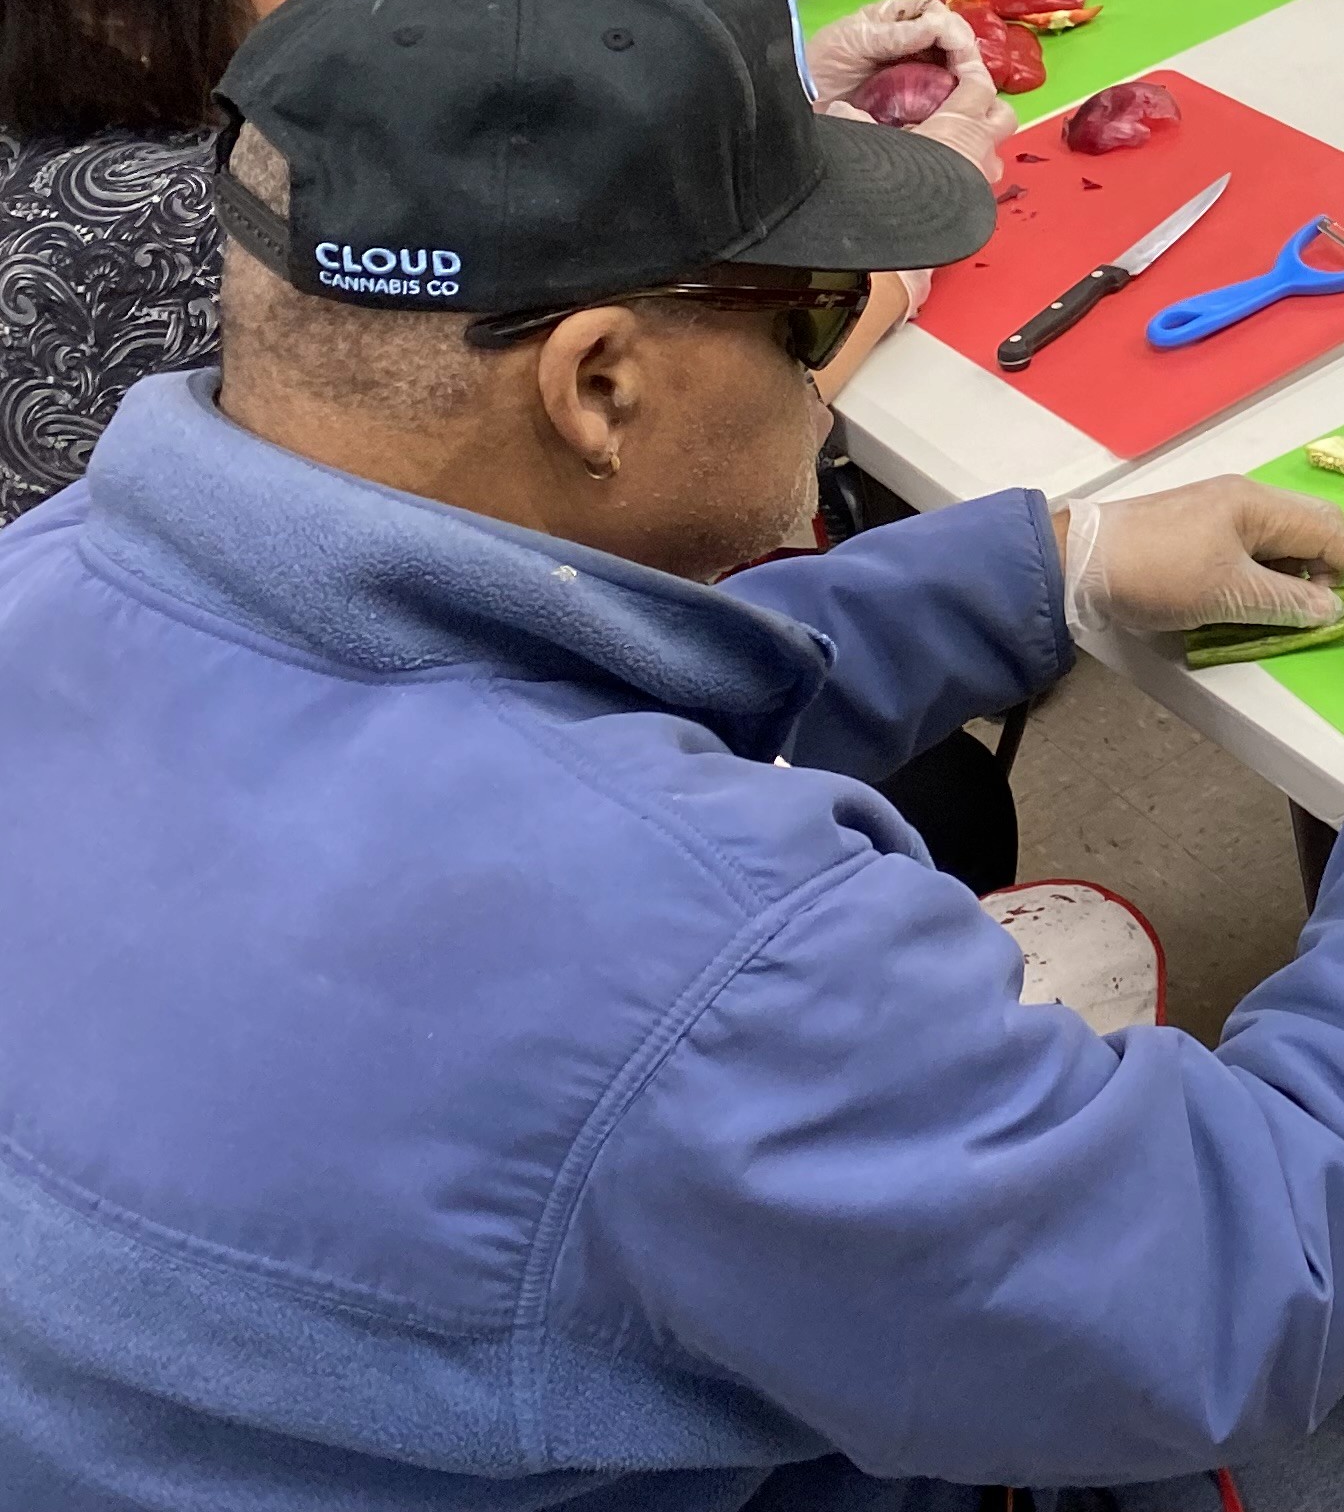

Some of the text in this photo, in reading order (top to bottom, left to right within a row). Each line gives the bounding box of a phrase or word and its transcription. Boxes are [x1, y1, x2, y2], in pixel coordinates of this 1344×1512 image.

[315, 242, 461, 276] CLOUD
[319, 271, 460, 296] CANNABIS CO
